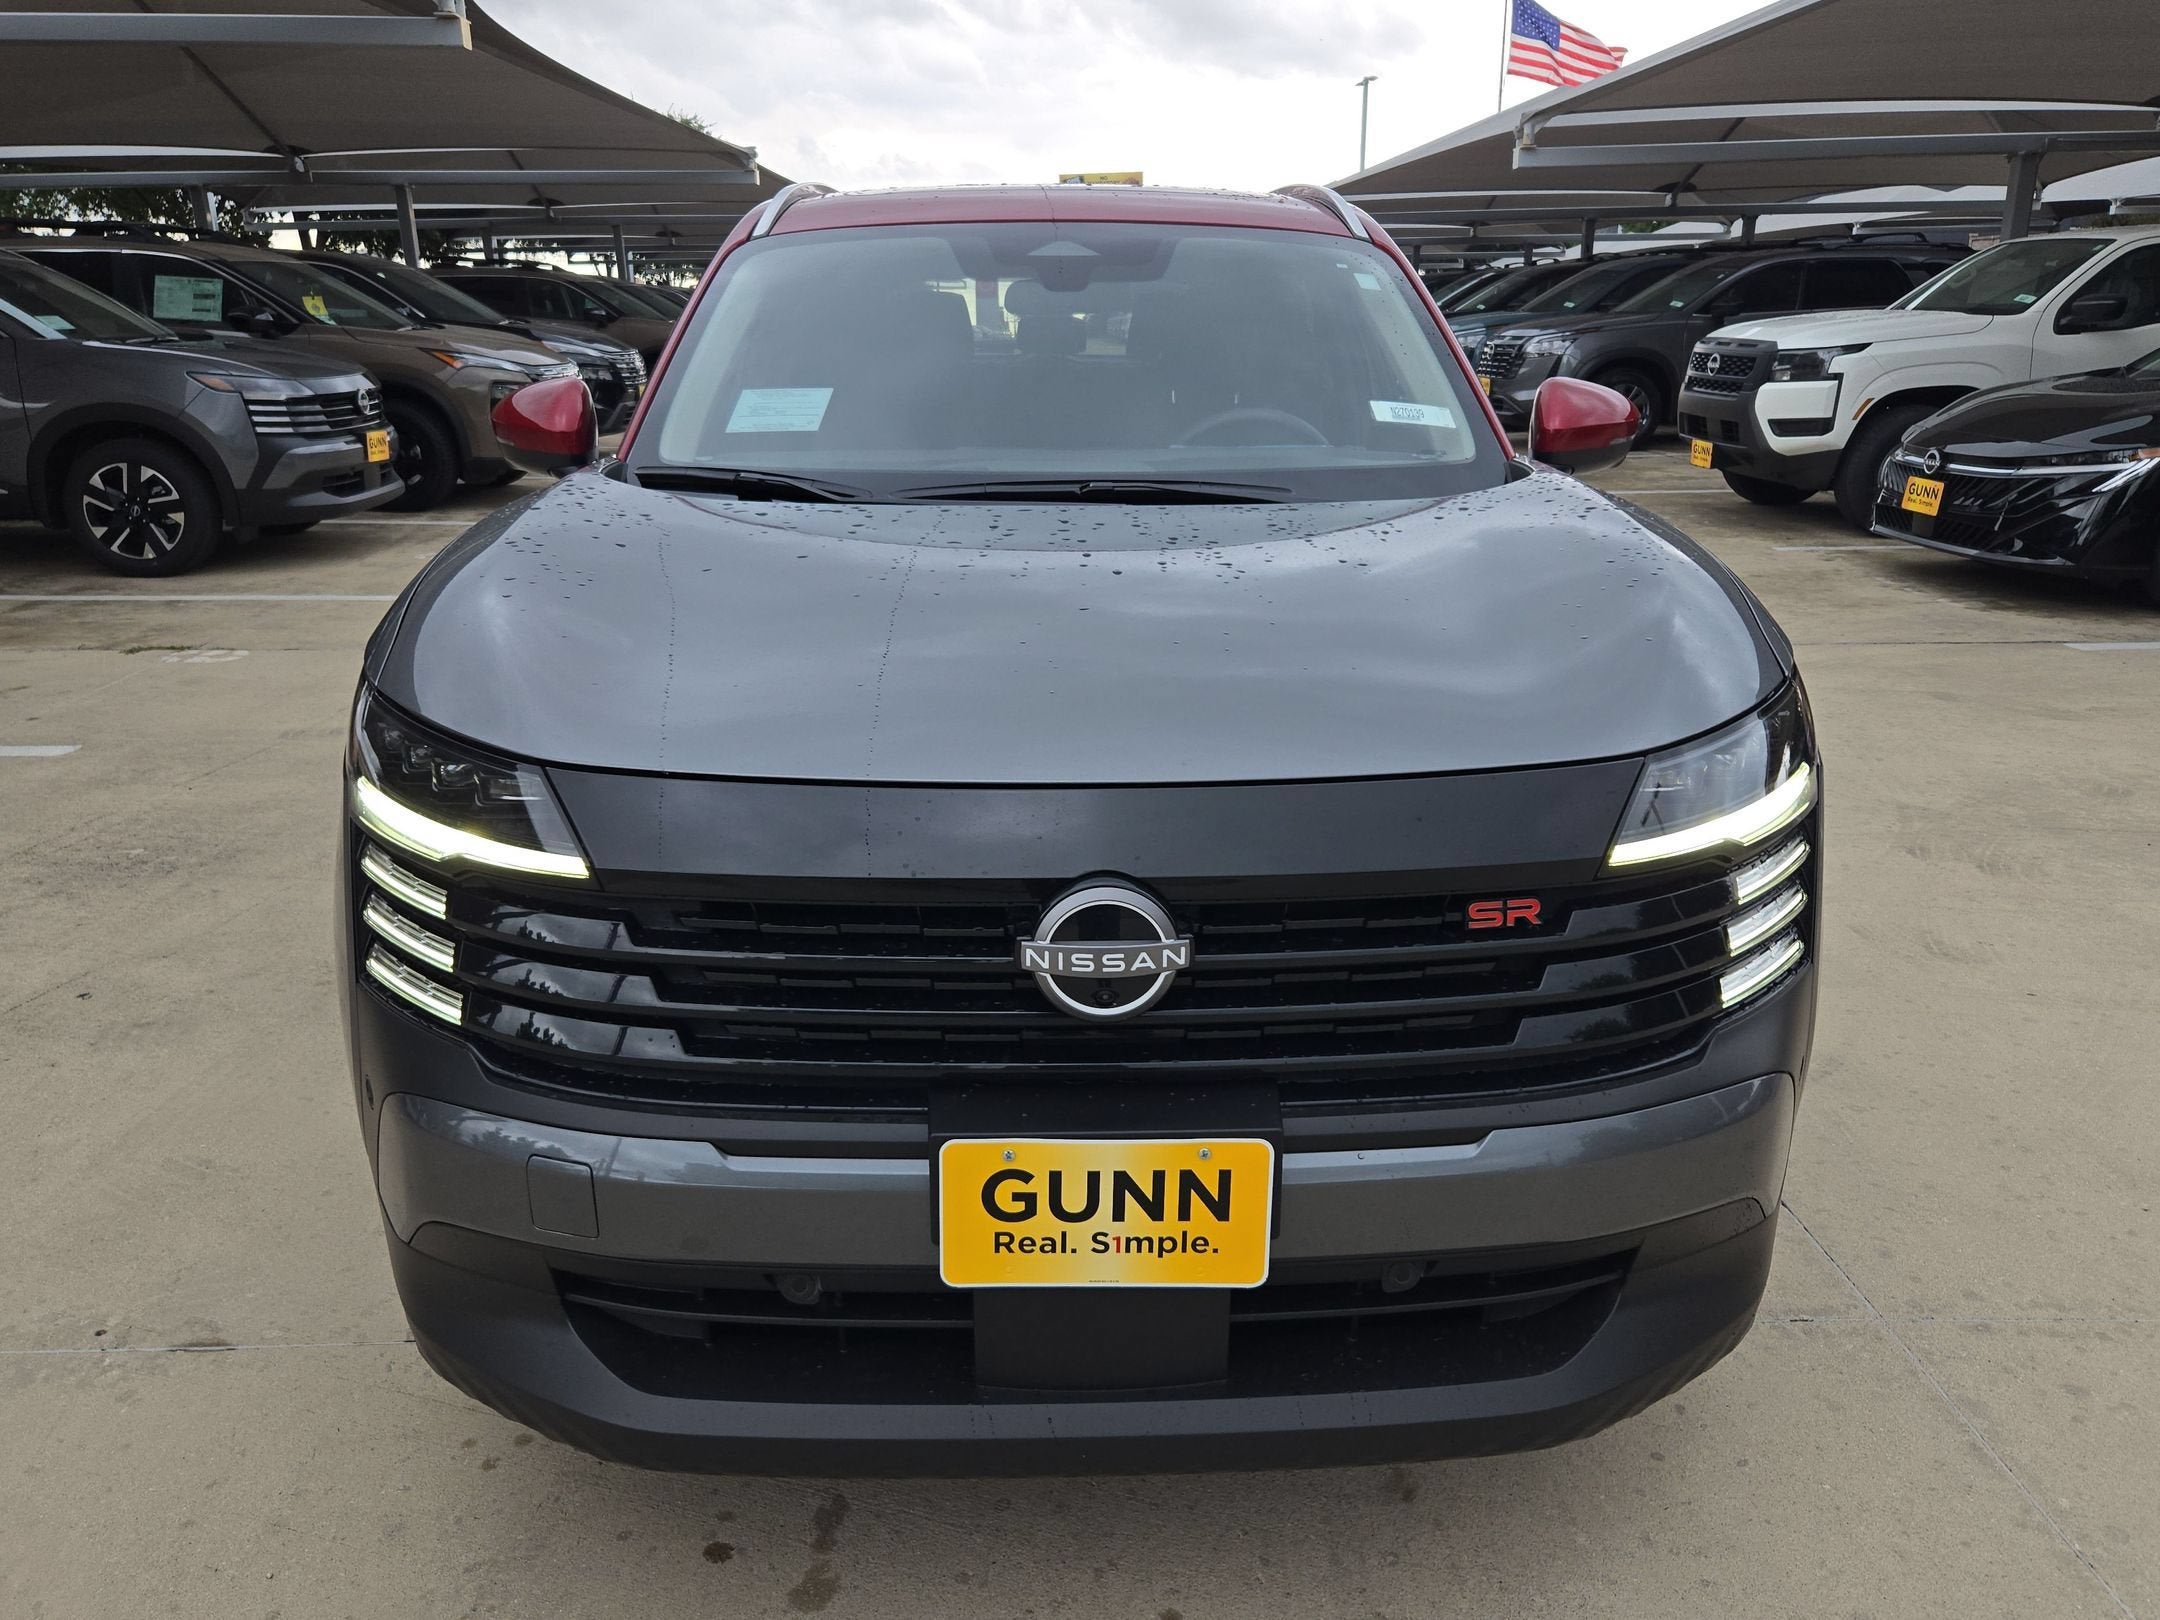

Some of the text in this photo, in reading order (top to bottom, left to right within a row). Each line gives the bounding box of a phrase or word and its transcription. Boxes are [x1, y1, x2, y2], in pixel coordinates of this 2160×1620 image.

[369, 436, 387, 449] GUNN
[1693, 444, 1710, 456] GUNN
[1909, 483, 1939, 500] GUNN
[1467, 898, 1542, 929] SR
[1025, 946, 1186, 973] NISSAN
[981, 1168, 1232, 1224] GUNN
[993, 1231, 1078, 1255] Real.
